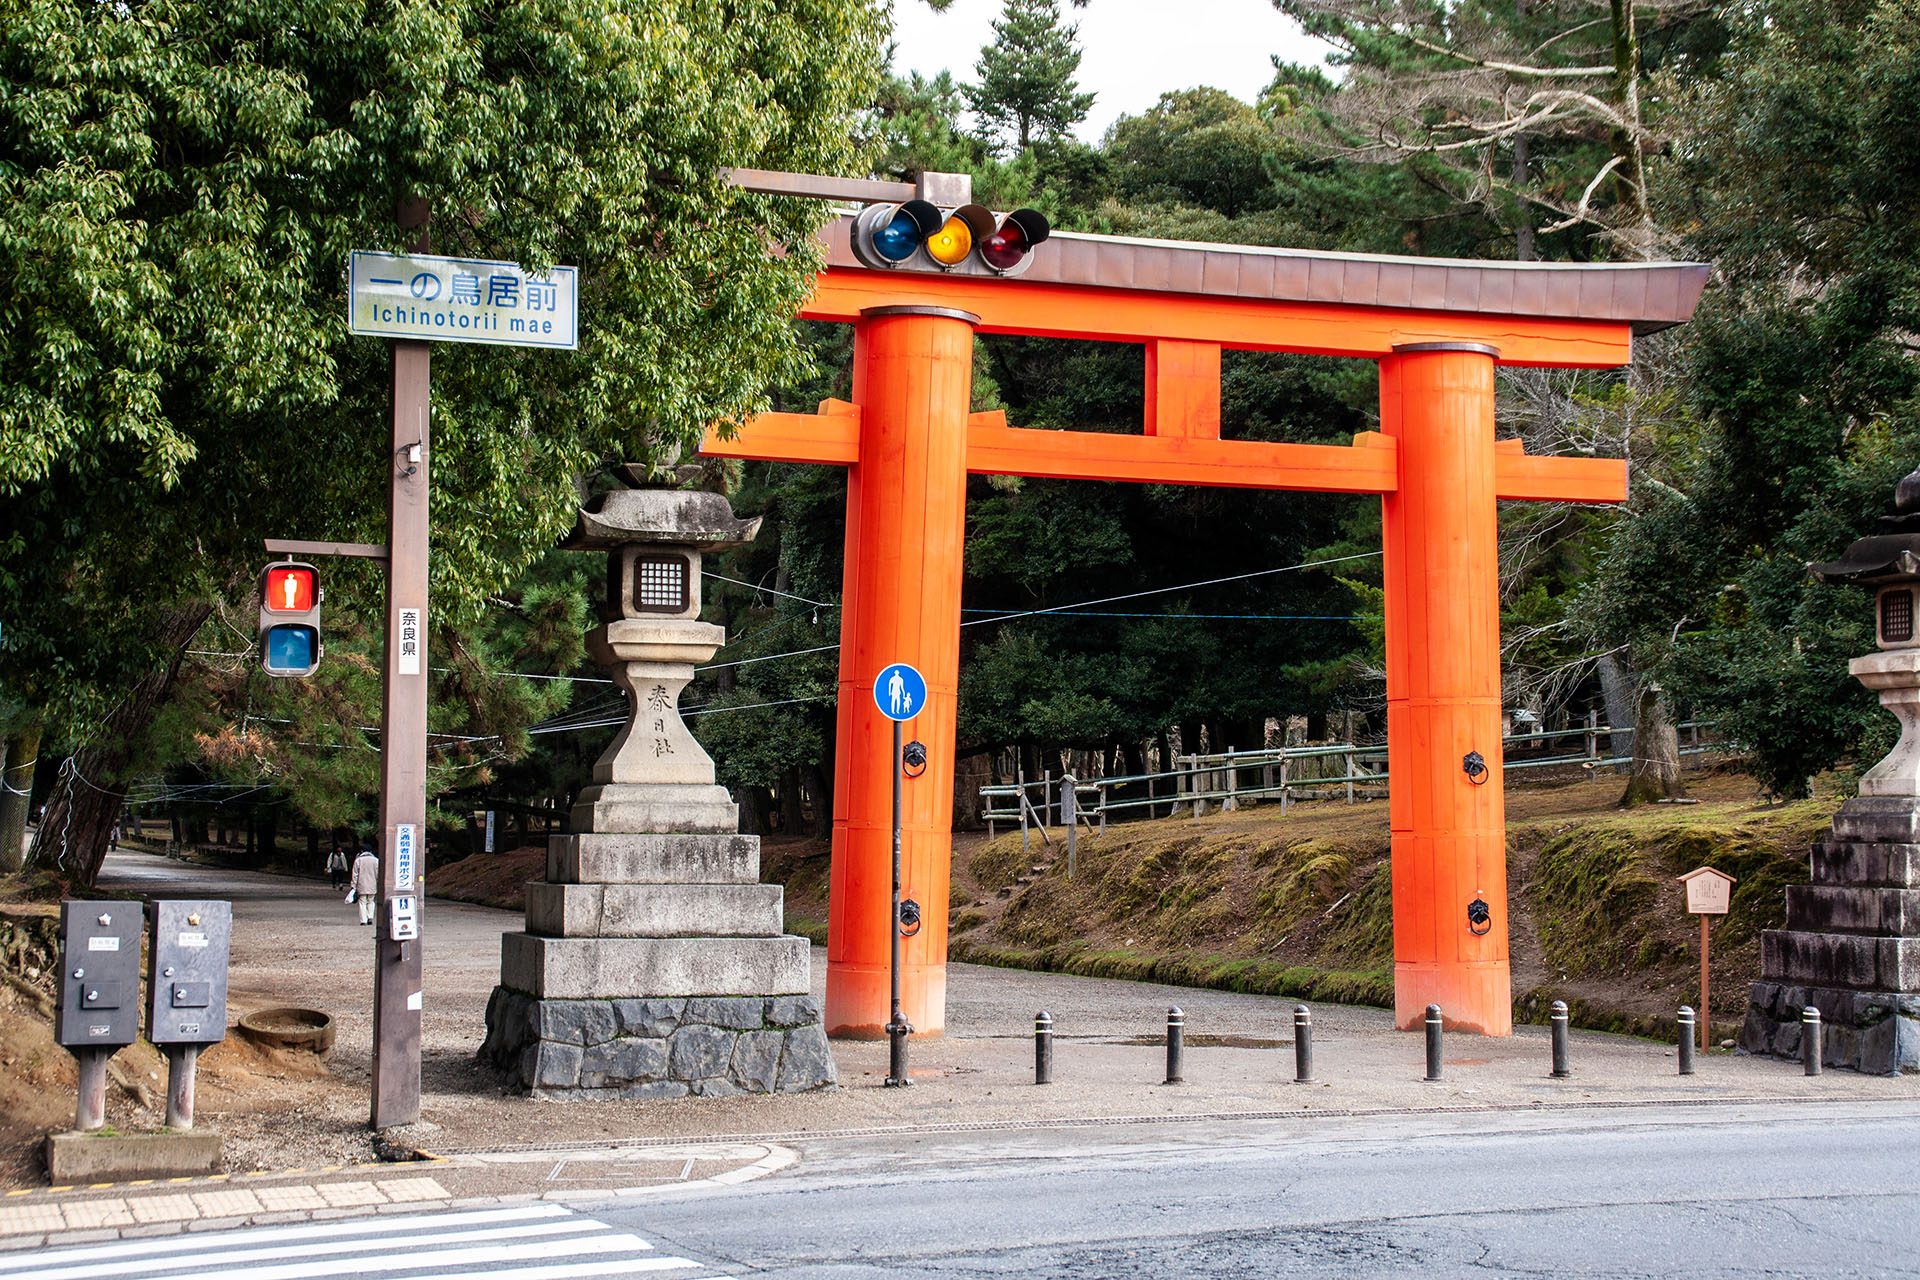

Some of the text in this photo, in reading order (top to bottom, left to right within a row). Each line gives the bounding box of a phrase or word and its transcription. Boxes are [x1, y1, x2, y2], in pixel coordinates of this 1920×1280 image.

[369, 271, 558, 312] 一の鳥居前
[373, 304, 553, 334] Ichinotorii mae
[402, 611, 417, 656] 奈良県
[399, 827, 411, 888] 交通弱者用押ボタン
